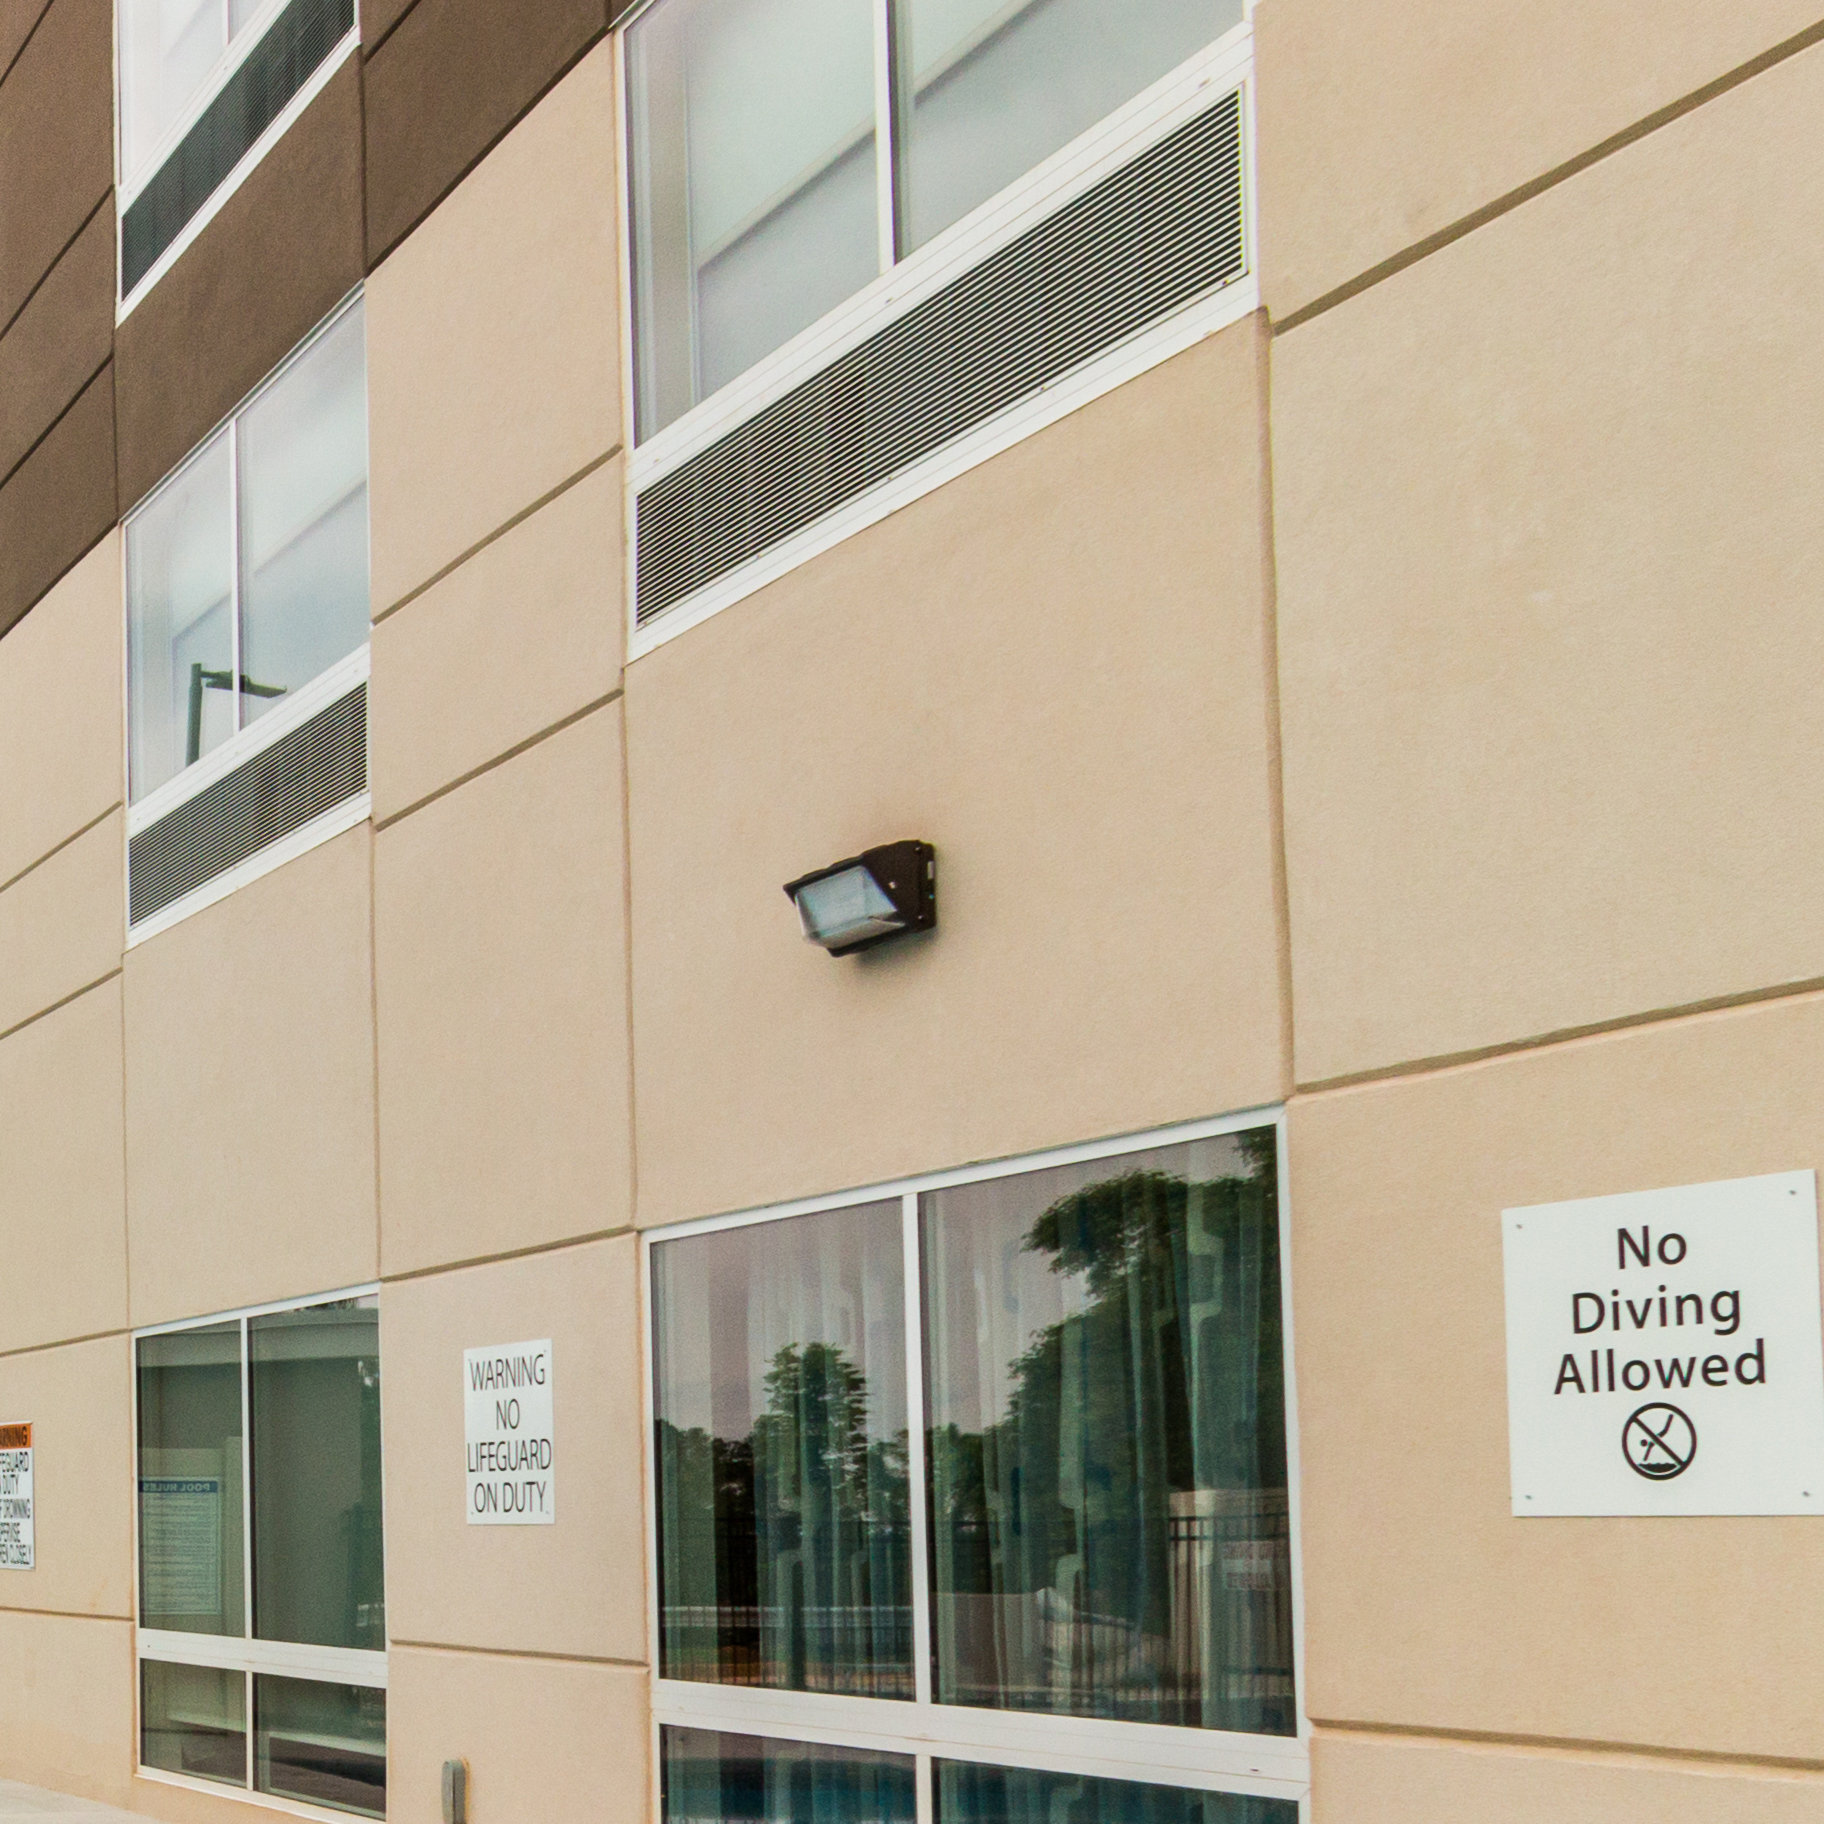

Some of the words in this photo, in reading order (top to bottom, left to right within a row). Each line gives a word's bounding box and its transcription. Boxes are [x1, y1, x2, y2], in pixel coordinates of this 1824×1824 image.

[1617, 1225, 1687, 1270] No
[1572, 1284, 1741, 1336] Diving
[470, 1354, 545, 1391] WARNING
[1554, 1337, 1766, 1395] Allowed
[496, 1398, 520, 1430] NO
[467, 1438, 552, 1472] LIFEGUARD
[3, 1474, 19, 1494] DUTY
[474, 1482, 497, 1512] ON
[503, 1481, 546, 1512] DUTY
